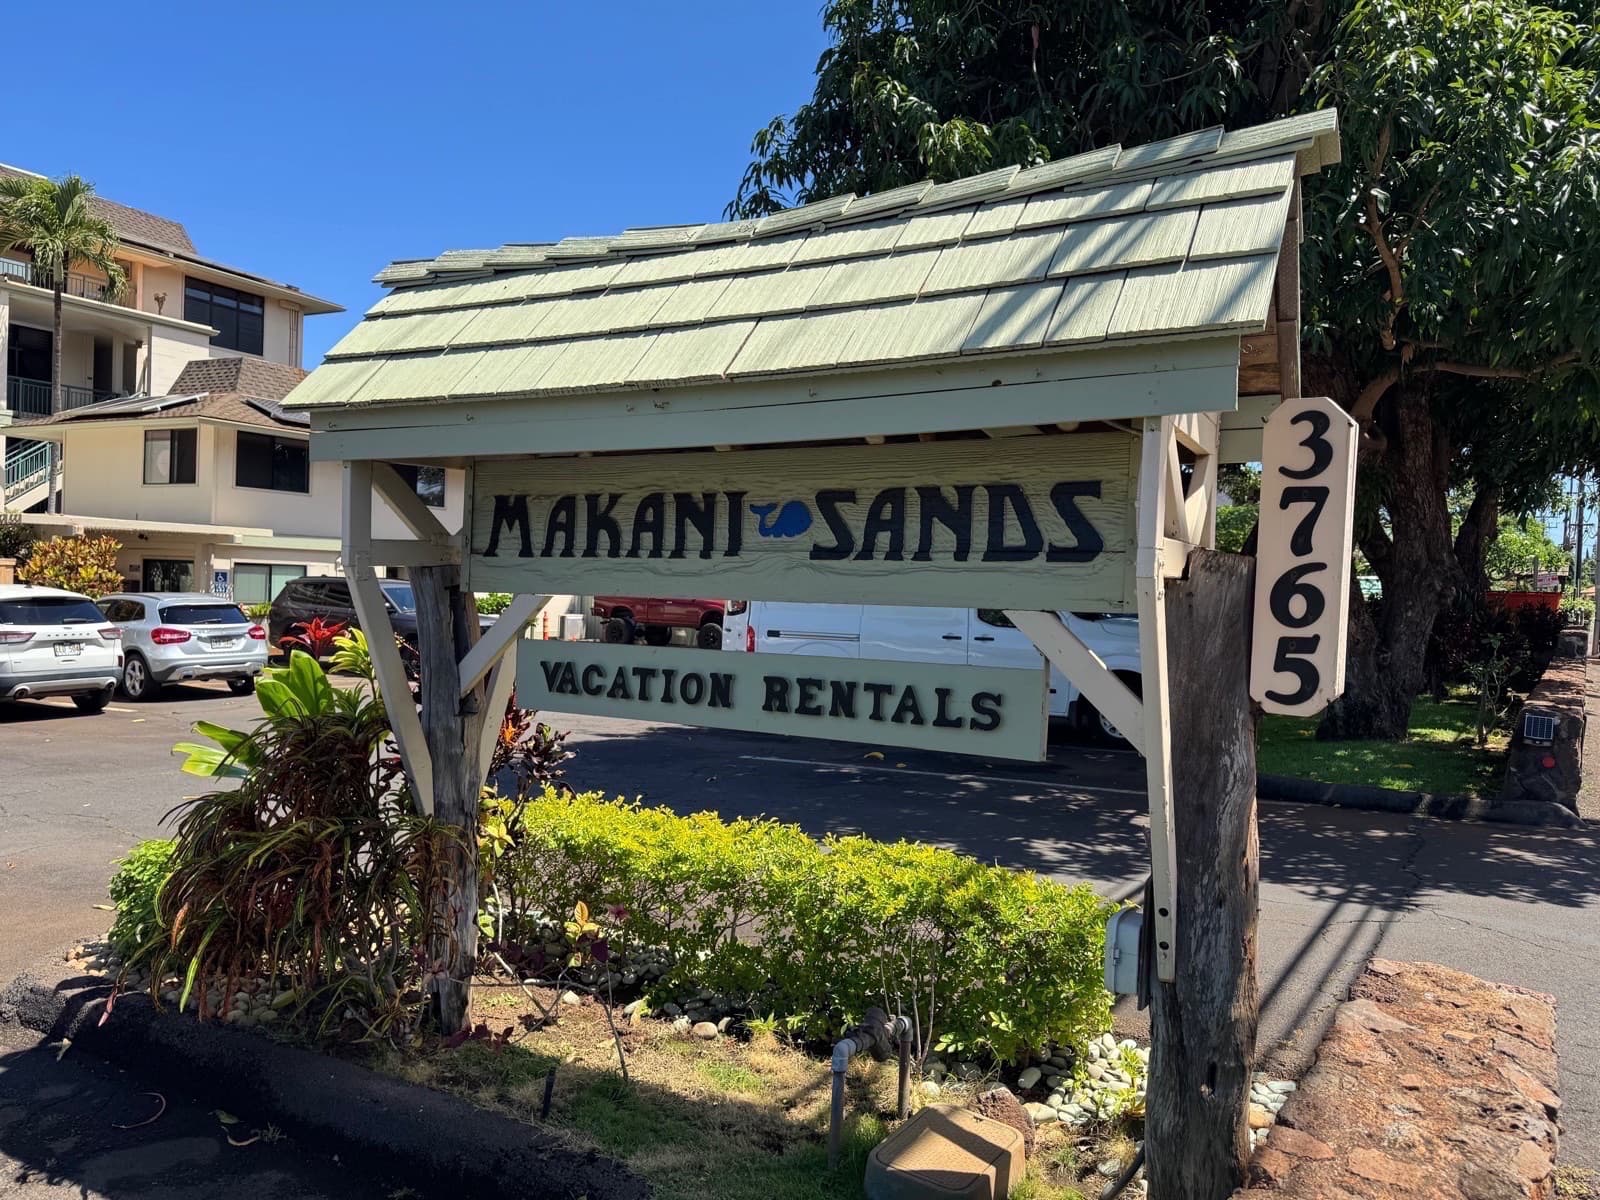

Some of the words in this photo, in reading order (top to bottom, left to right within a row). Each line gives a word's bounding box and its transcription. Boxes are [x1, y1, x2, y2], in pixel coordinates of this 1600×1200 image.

[484, 491, 749, 559] MAKANI
[809, 480, 1104, 562] SANDS
[1265, 410, 1333, 705] 3765
[540, 660, 734, 708] VACATION
[763, 675, 1004, 731] RENTALS
